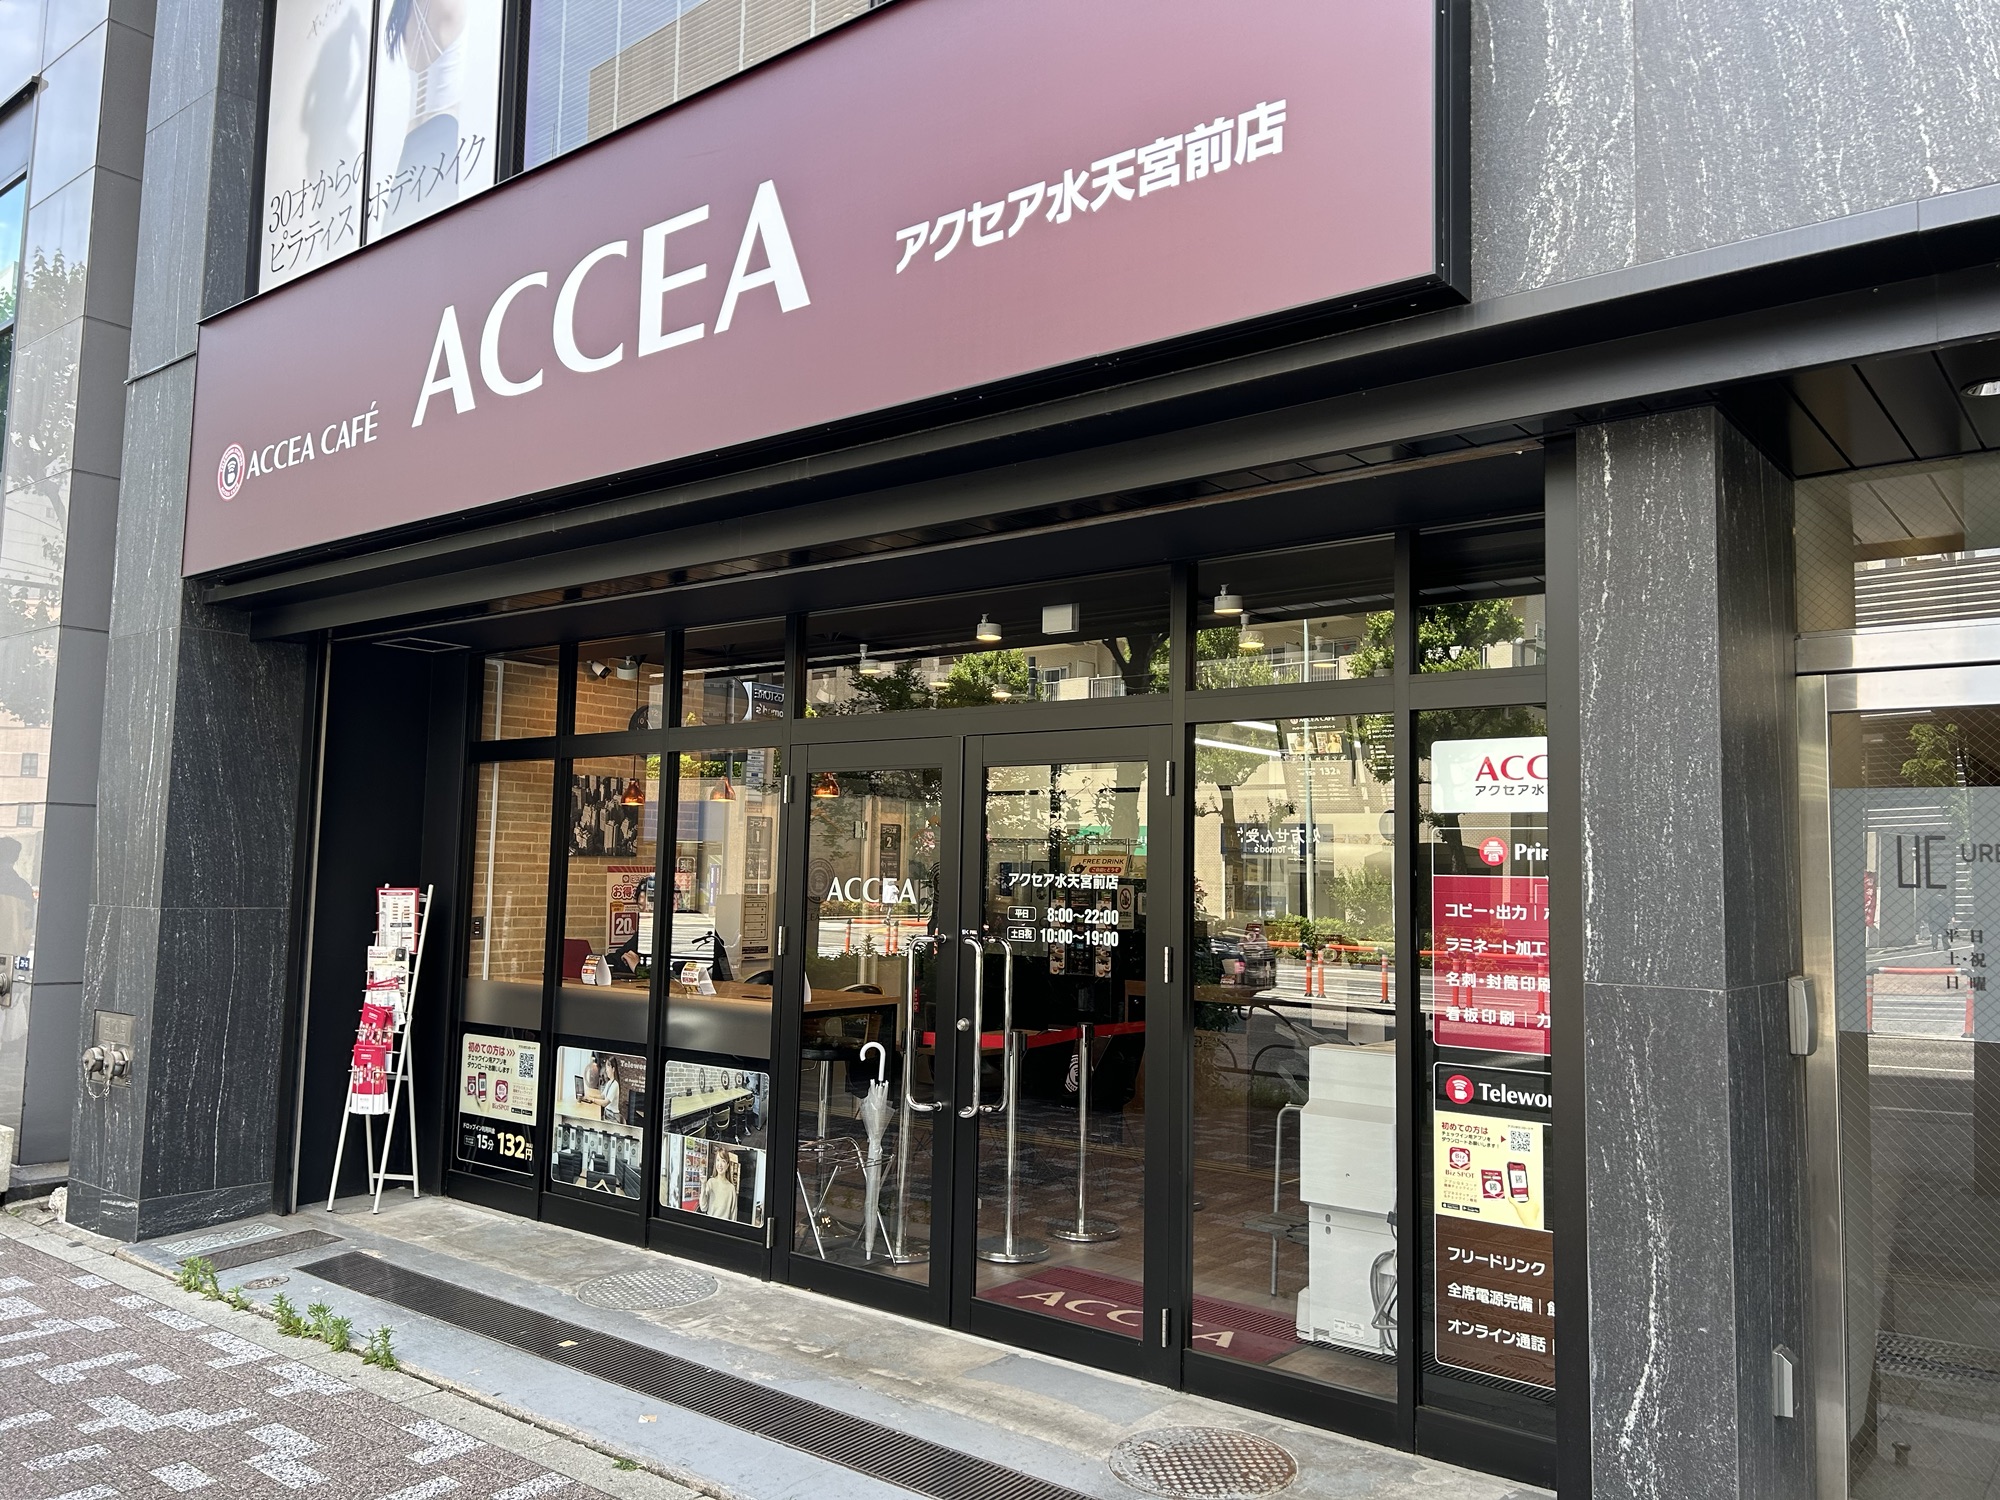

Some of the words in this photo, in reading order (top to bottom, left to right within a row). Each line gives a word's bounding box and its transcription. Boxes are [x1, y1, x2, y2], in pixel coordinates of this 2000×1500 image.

[269, 151, 365, 233] 30才からの
[896, 99, 1286, 274] アクセア水天宮前店
[411, 179, 811, 428] ACCEA
[247, 432, 315, 479] ACCEA
[321, 401, 379, 454] CAFÉ
[1475, 784, 1545, 796] アクセア水
[886, 837, 892, 848] 2
[826, 877, 918, 905] ACCEA
[1008, 873, 1119, 890] アクセア水天宮前店
[1014, 908, 1030, 919] 平日
[1445, 903, 1527, 921] コピー・出力
[1010, 928, 1033, 940] 土日祝
[1446, 938, 1547, 957] ラミネート加工
[1445, 971, 1550, 993] 名刺・封筒印刷
[1446, 1006, 1515, 1027] 看板印刷
[468, 1042, 505, 1057] 初めての方は
[1441, 1122, 1488, 1135] 初めての方は
[477, 1133, 494, 1151] 15分
[1448, 1247, 1546, 1276] フリードリンク
[1447, 1282, 1534, 1313] 全席電源完備
[1448, 1319, 1547, 1353] オンライン通話
